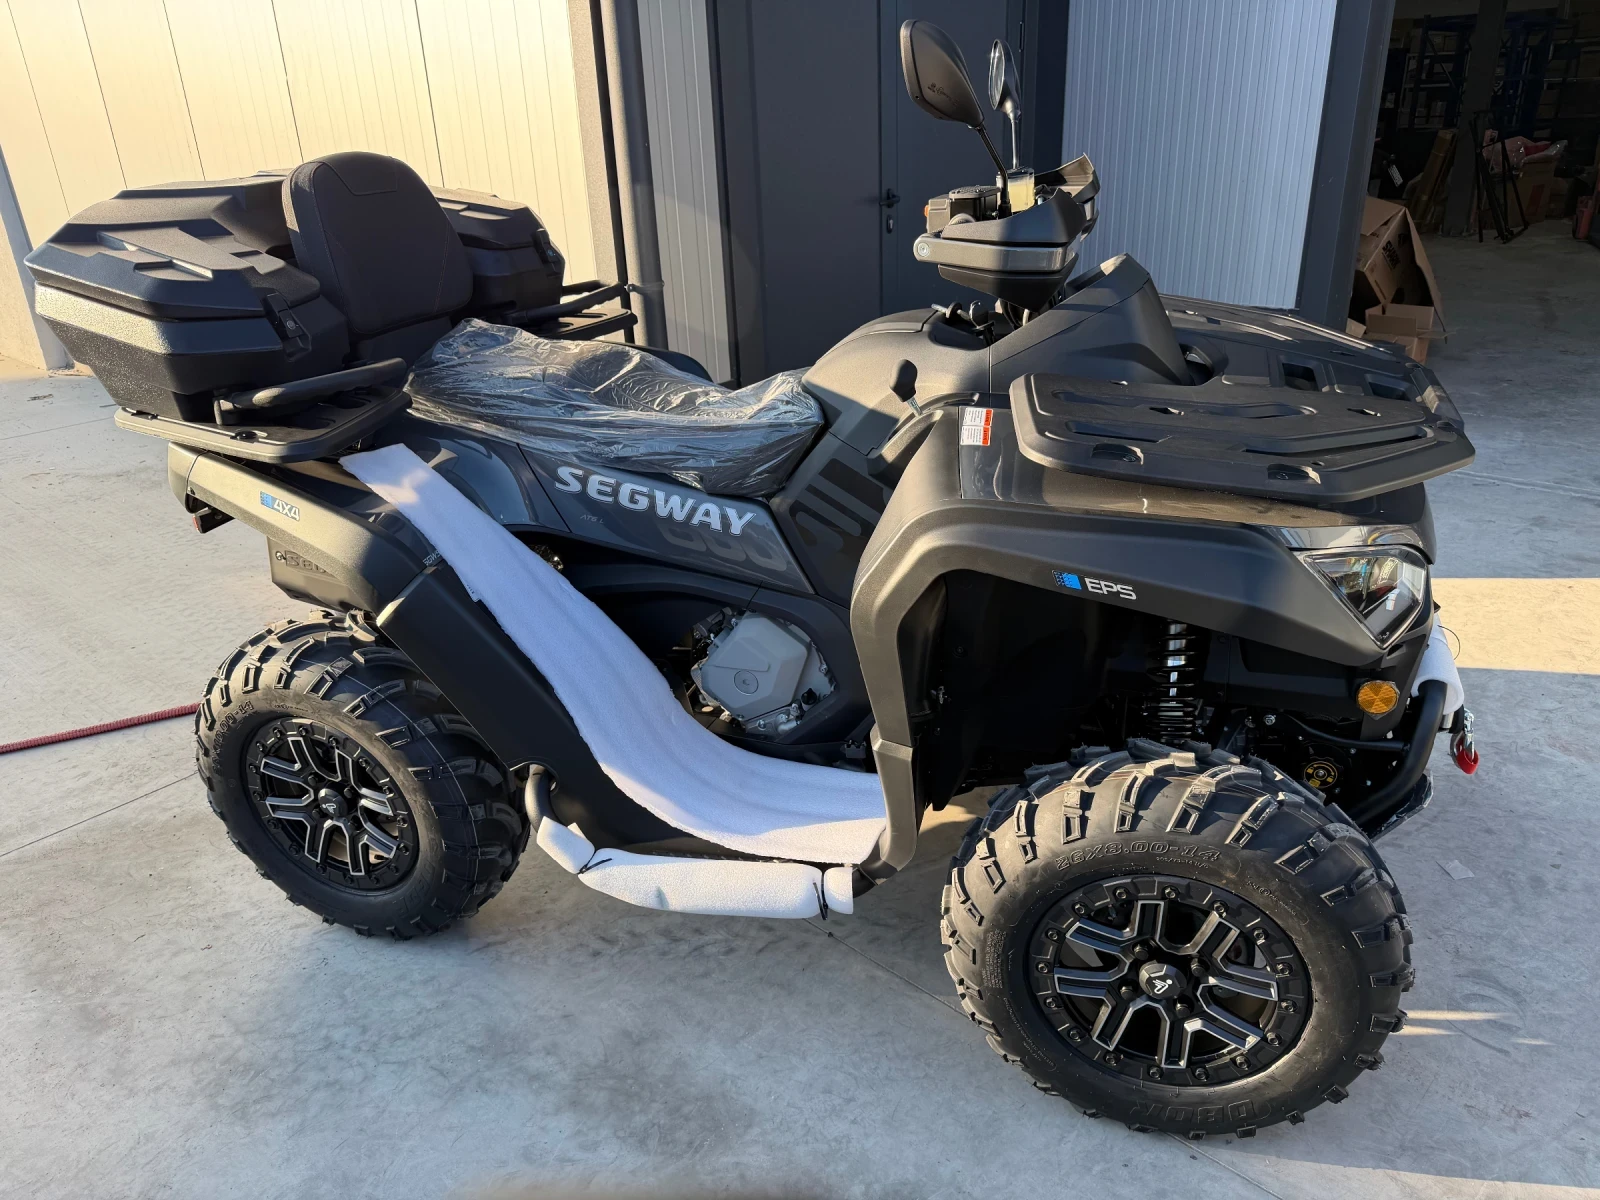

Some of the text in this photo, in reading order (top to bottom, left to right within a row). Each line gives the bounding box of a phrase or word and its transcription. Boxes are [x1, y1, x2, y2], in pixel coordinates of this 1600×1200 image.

[274, 499, 300, 521] 4X4
[554, 466, 757, 537] SEGWAY
[1084, 577, 1137, 600] EPS
[1055, 840, 1222, 871] 26X8.00-14
